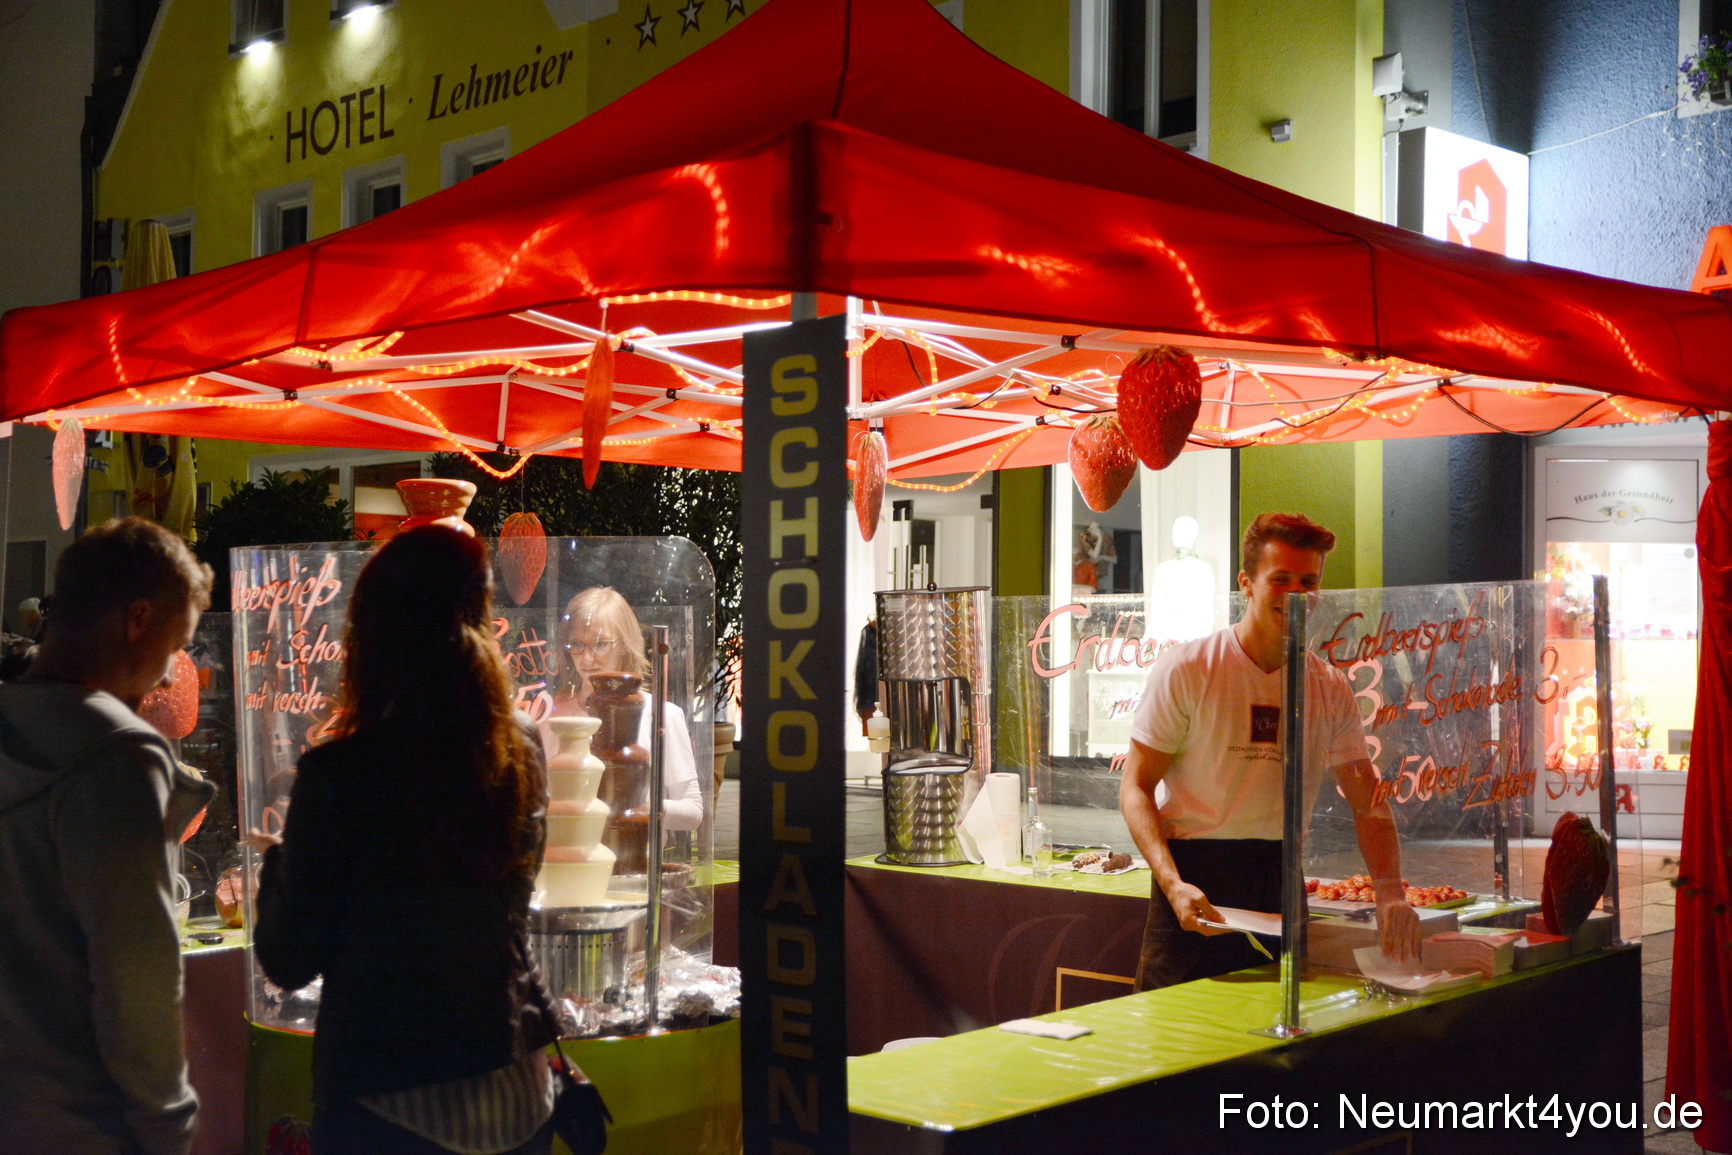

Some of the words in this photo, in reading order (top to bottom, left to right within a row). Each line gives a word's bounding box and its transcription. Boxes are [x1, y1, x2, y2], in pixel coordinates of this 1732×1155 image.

[286, 84, 395, 164] HOTEL
[426, 44, 574, 121] Lehmeier
[1574, 493, 1599, 504] Haus
[1601, 490, 1616, 498] der
[1619, 489, 1674, 505] Gesundheit
[1320, 591, 1487, 675] Erdbeerspieß
[767, 354, 823, 1155] SCHOKOLADEN
